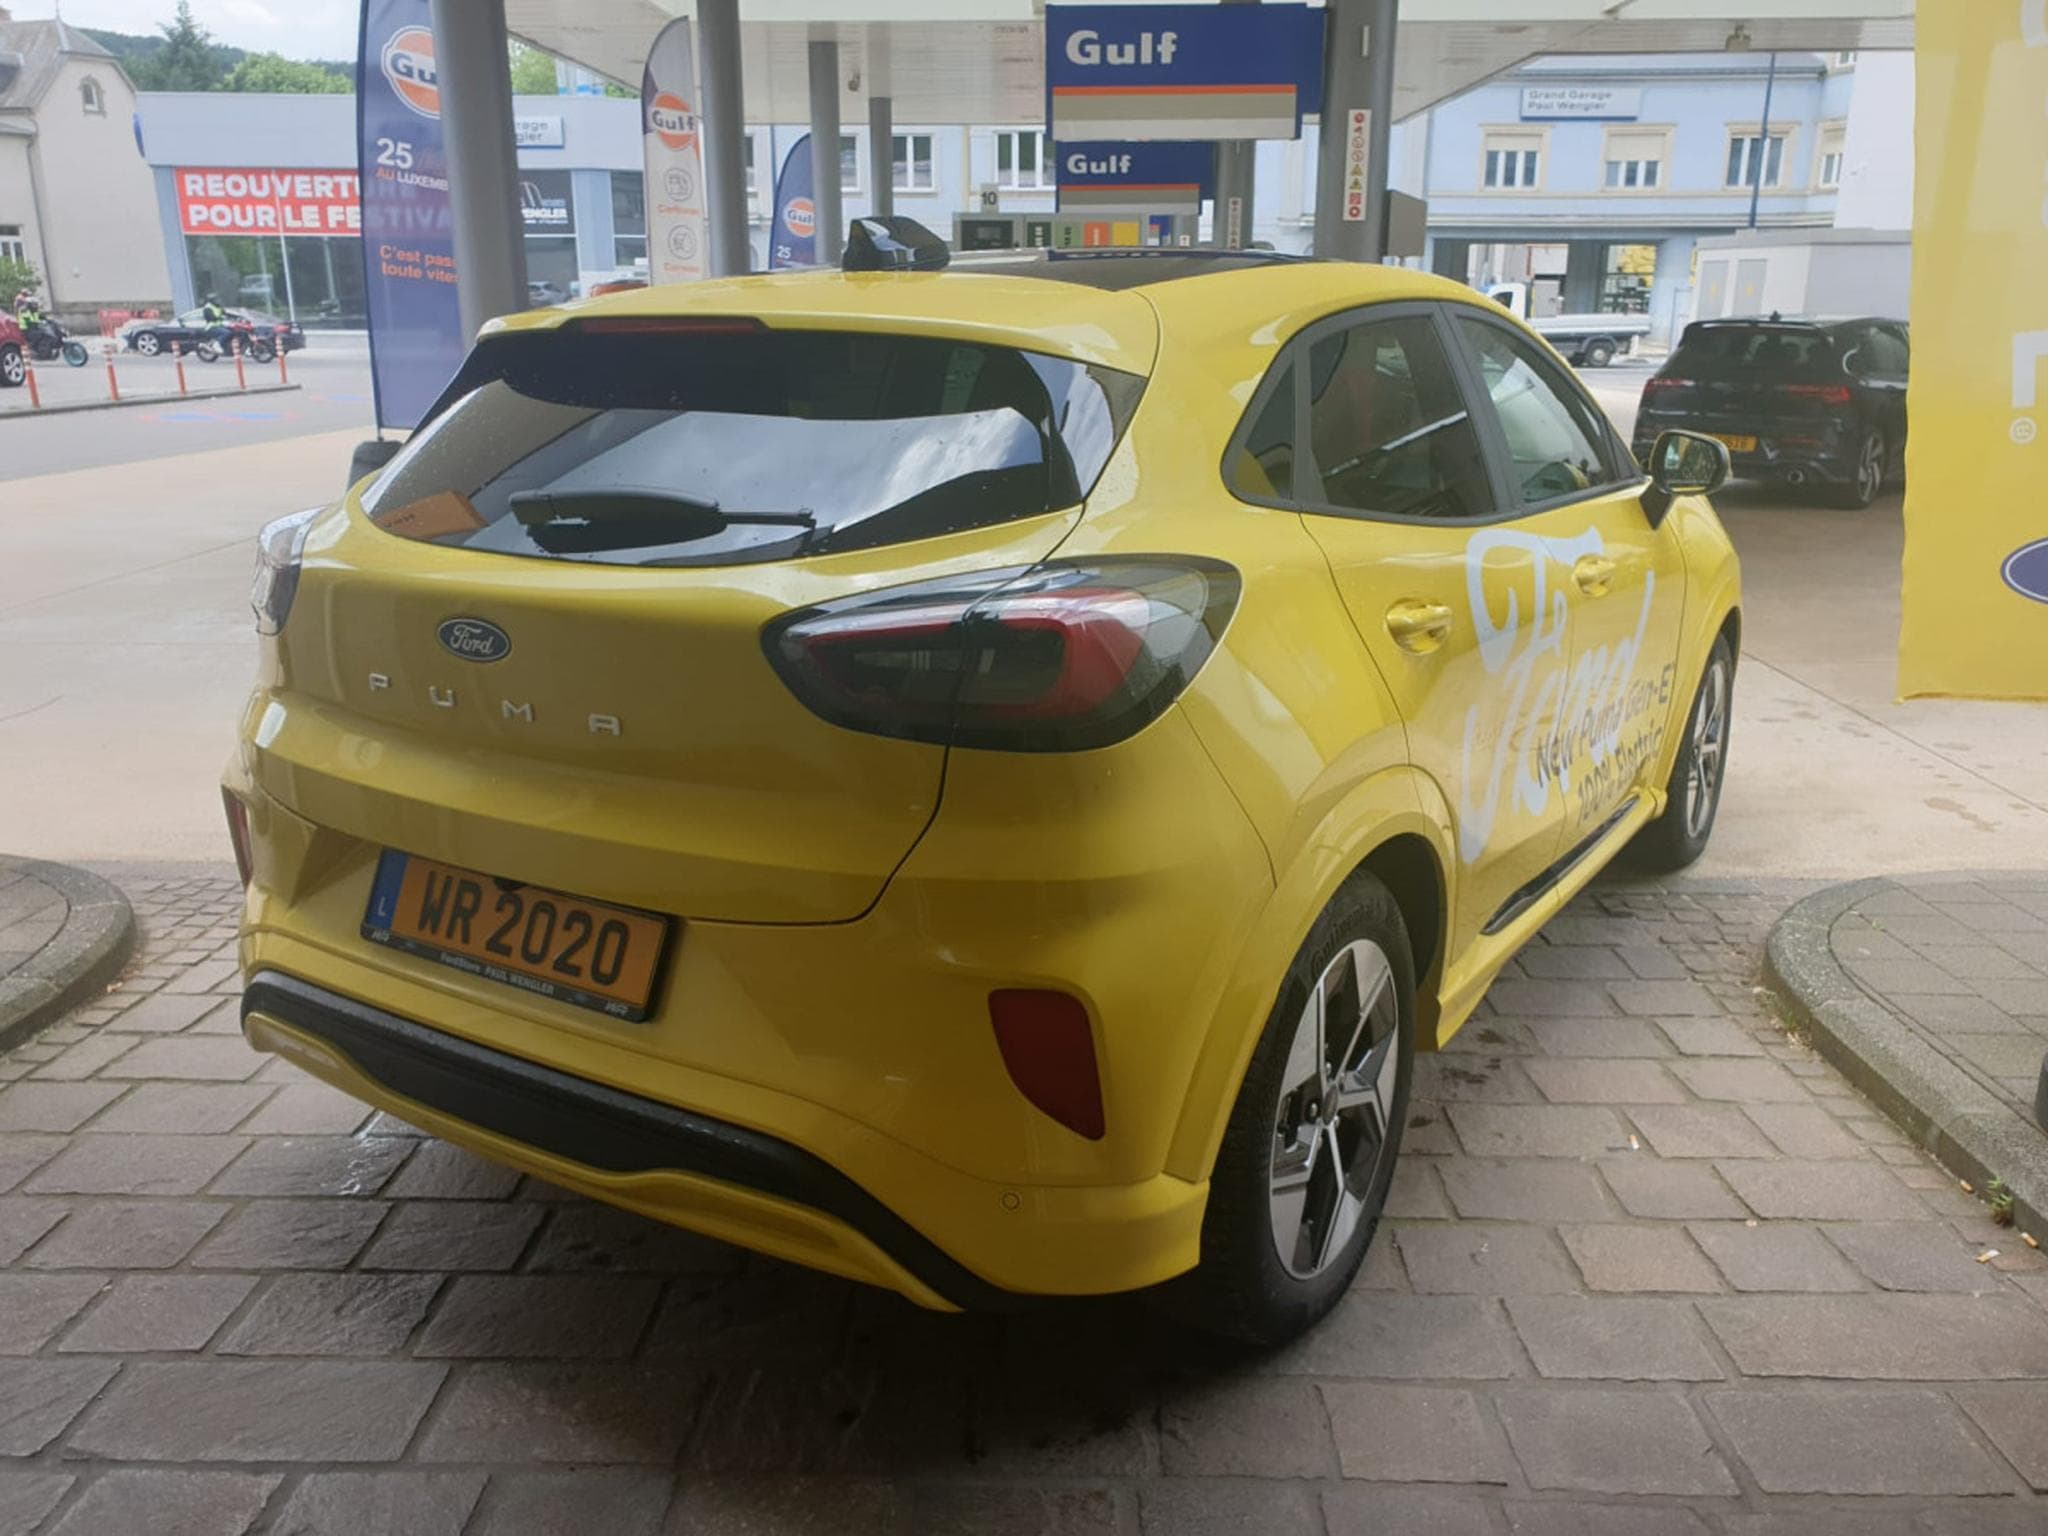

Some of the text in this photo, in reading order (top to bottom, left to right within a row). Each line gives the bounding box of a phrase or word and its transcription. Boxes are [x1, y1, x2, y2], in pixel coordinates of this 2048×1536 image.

[1066, 30, 1178, 65] Gulf
[652, 109, 695, 131] Gulf
[377, 138, 412, 169] 25
[1067, 154, 1131, 174] Gulf
[377, 166, 395, 181] AU
[981, 191, 998, 205] 10
[188, 204, 276, 227] POUR
[284, 205, 320, 228] LE
[788, 209, 815, 225] Gul
[380, 245, 420, 263] C'est
[777, 246, 791, 259] 25
[382, 261, 421, 279] toute
[450, 624, 494, 655] Ford
[368, 672, 621, 736] PUMA
[1459, 524, 1655, 864] Ford
[378, 870, 631, 986] L WR 2020
